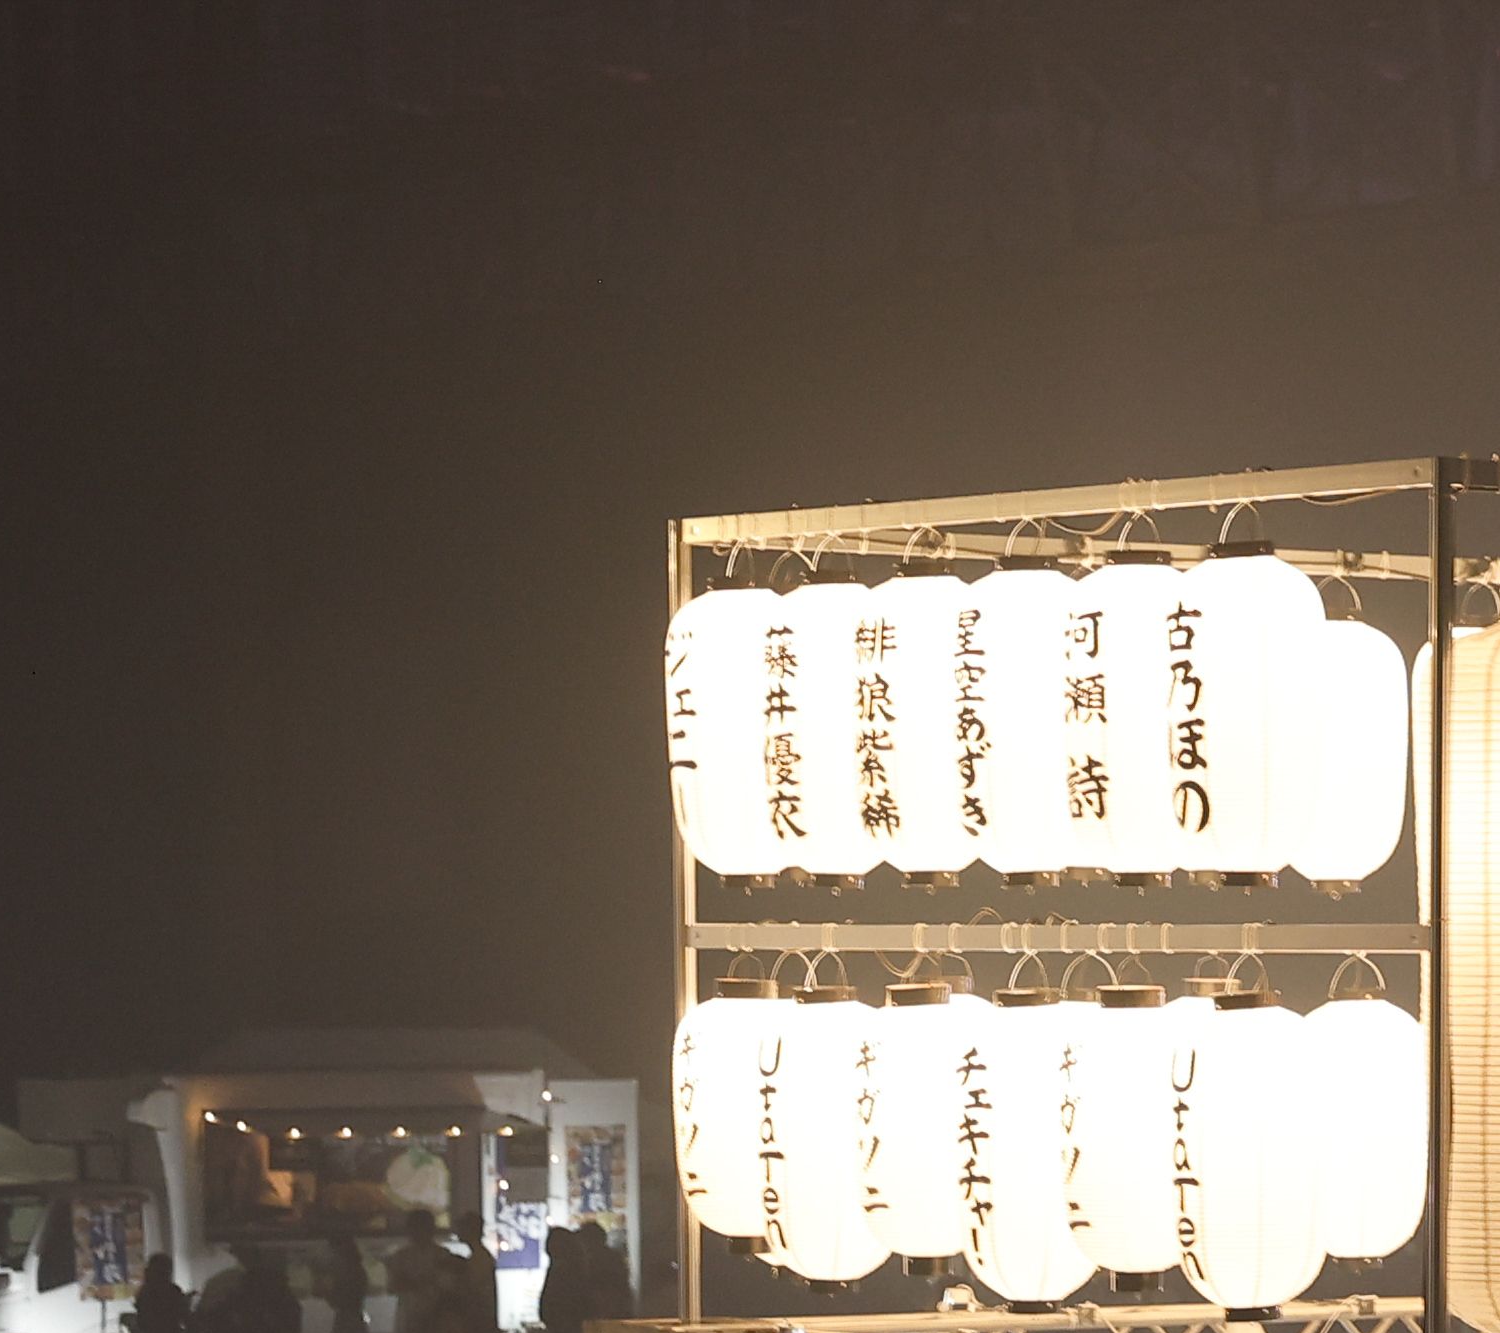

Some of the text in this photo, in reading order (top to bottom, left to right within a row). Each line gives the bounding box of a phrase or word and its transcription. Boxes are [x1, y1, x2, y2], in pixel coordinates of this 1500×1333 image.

[954, 609, 992, 837] 星空あずき
[1166, 601, 1211, 833] 古乃ほの
[758, 1036, 788, 1250] UtaTen
[1171, 1049, 1204, 1281] UtaTen
